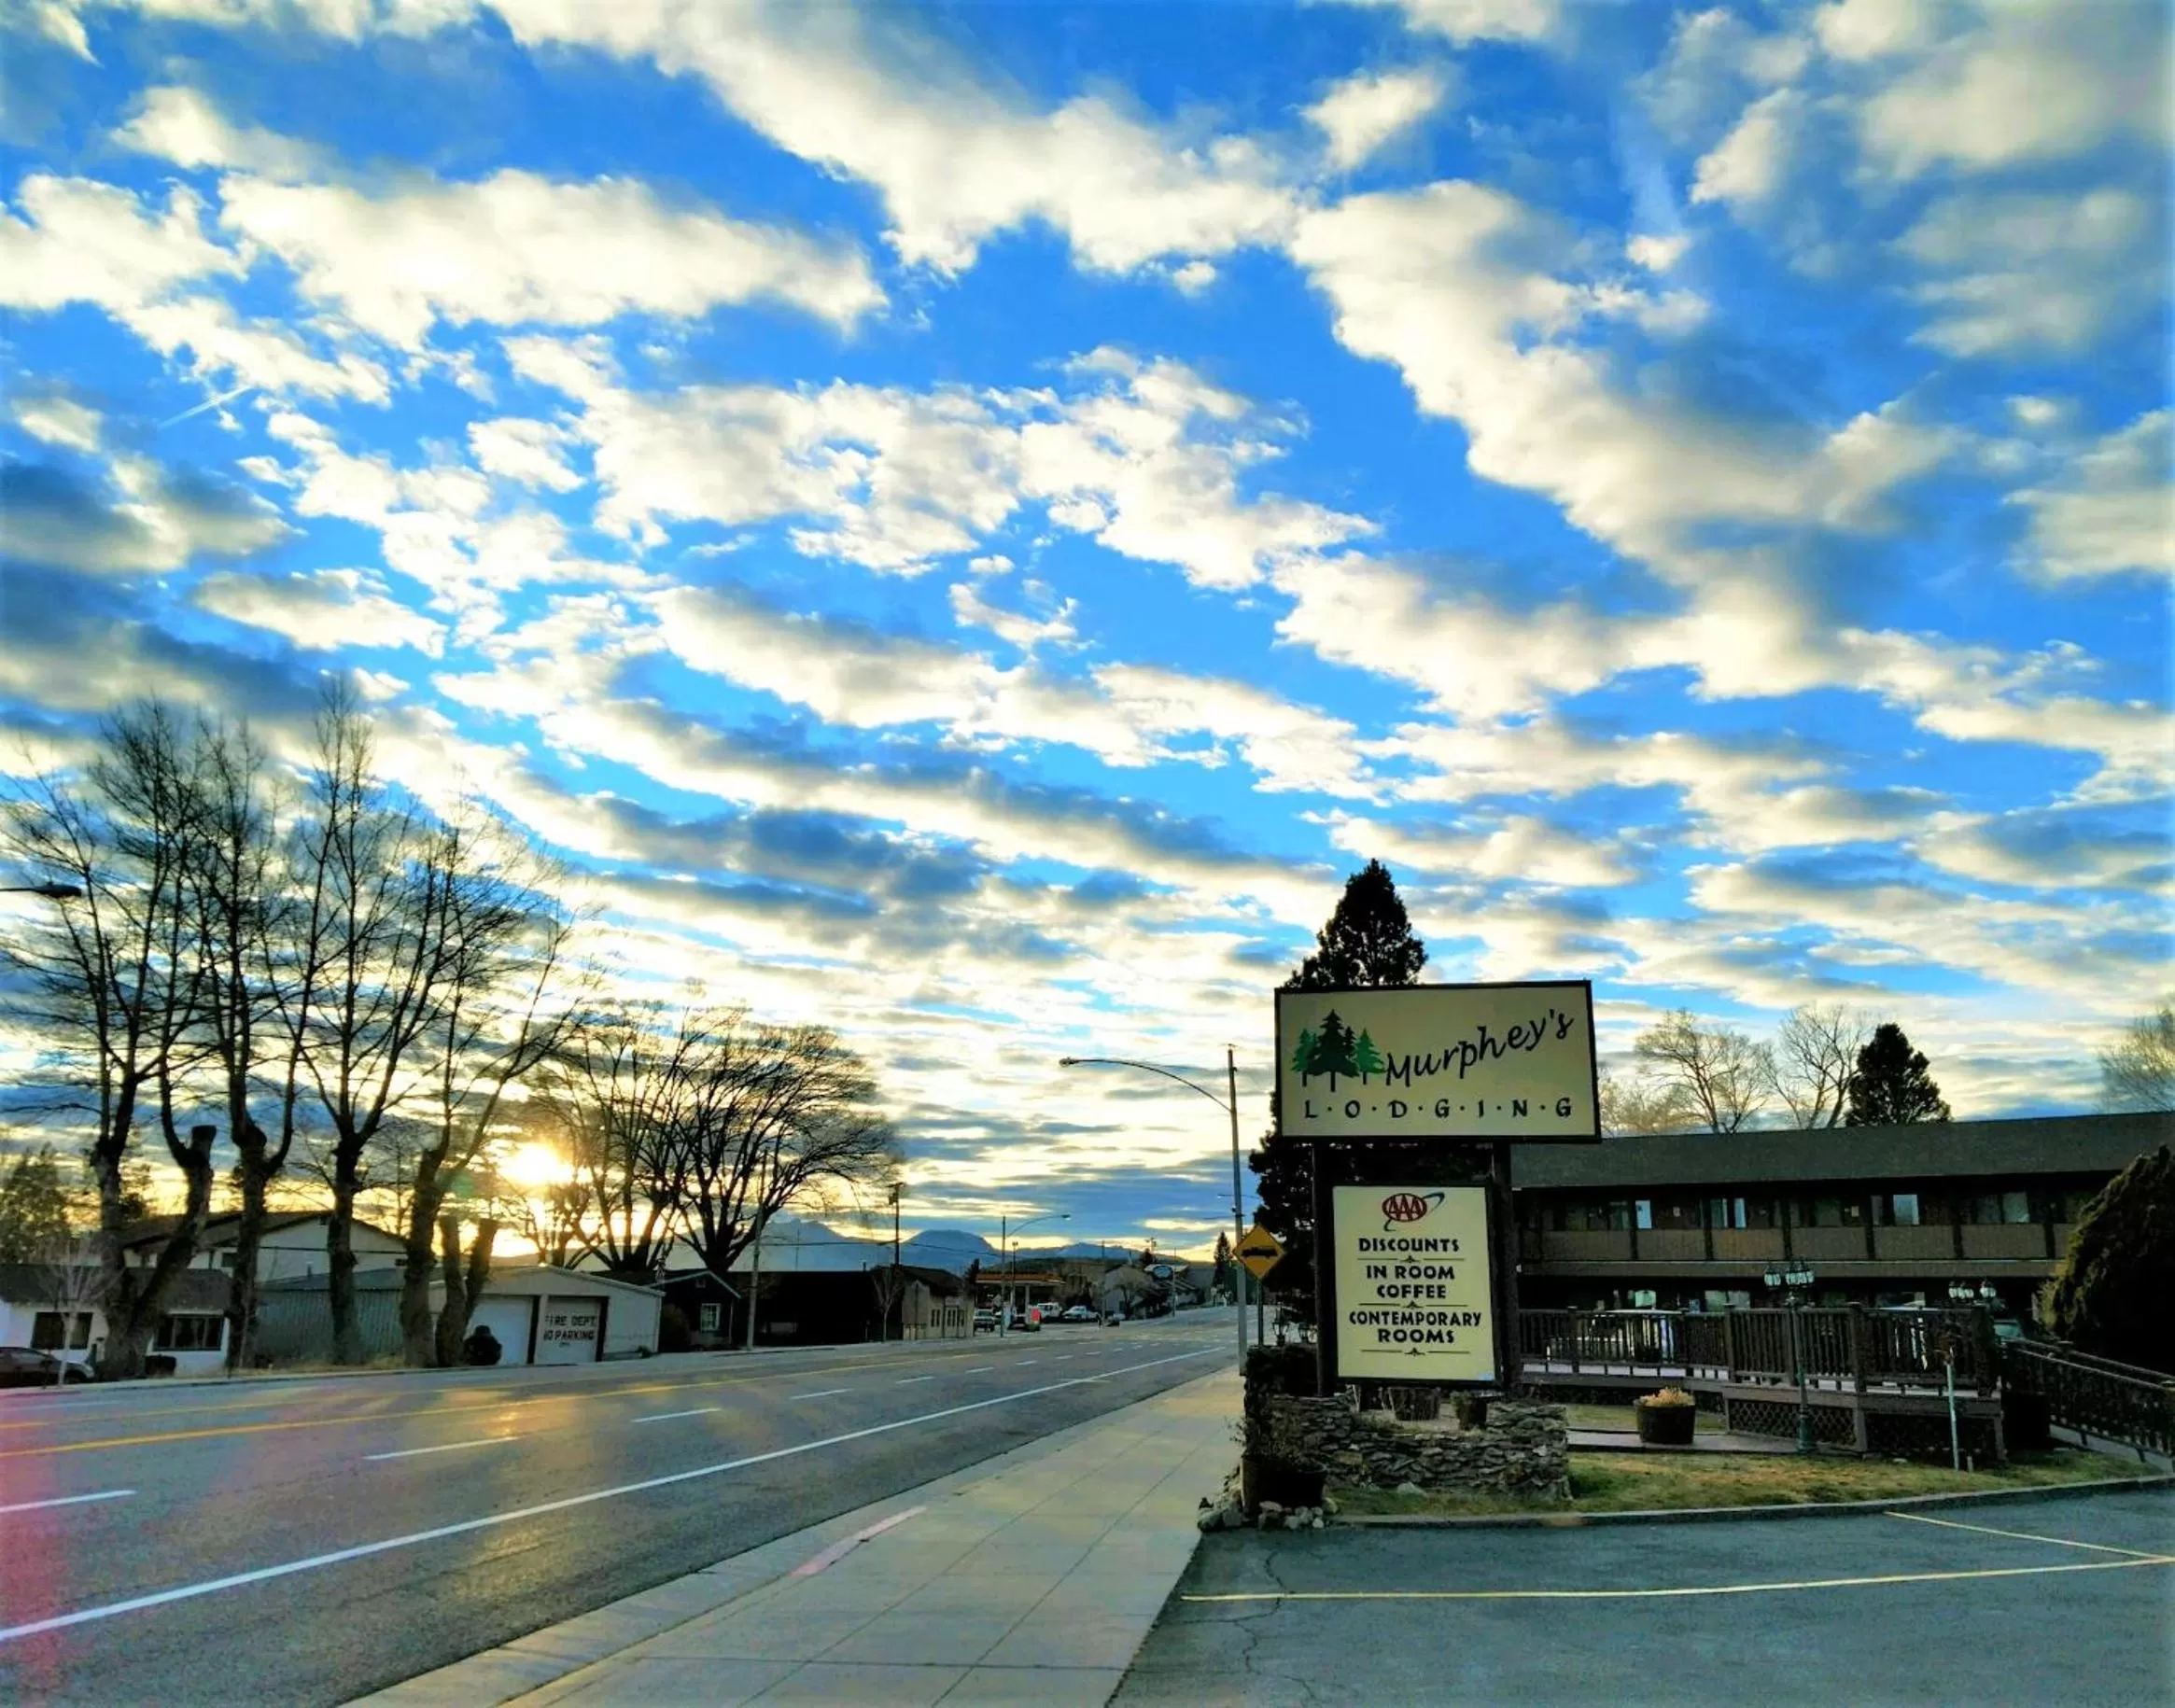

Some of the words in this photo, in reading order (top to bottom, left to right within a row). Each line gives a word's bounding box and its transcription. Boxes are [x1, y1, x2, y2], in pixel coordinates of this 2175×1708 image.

[1385, 1009, 1575, 1087] Murphey's
[1388, 1195, 1422, 1221] AAA
[1358, 1238, 1460, 1253] DISCOUNTS
[1366, 1265, 1387, 1279] IN
[1395, 1266, 1455, 1280] ROOM
[1377, 1284, 1447, 1298] COFFEE
[1349, 1310, 1482, 1326] CONTEMPORARY
[554, 1329, 595, 1341] PARKING
[1378, 1328, 1454, 1344] ROOMS
